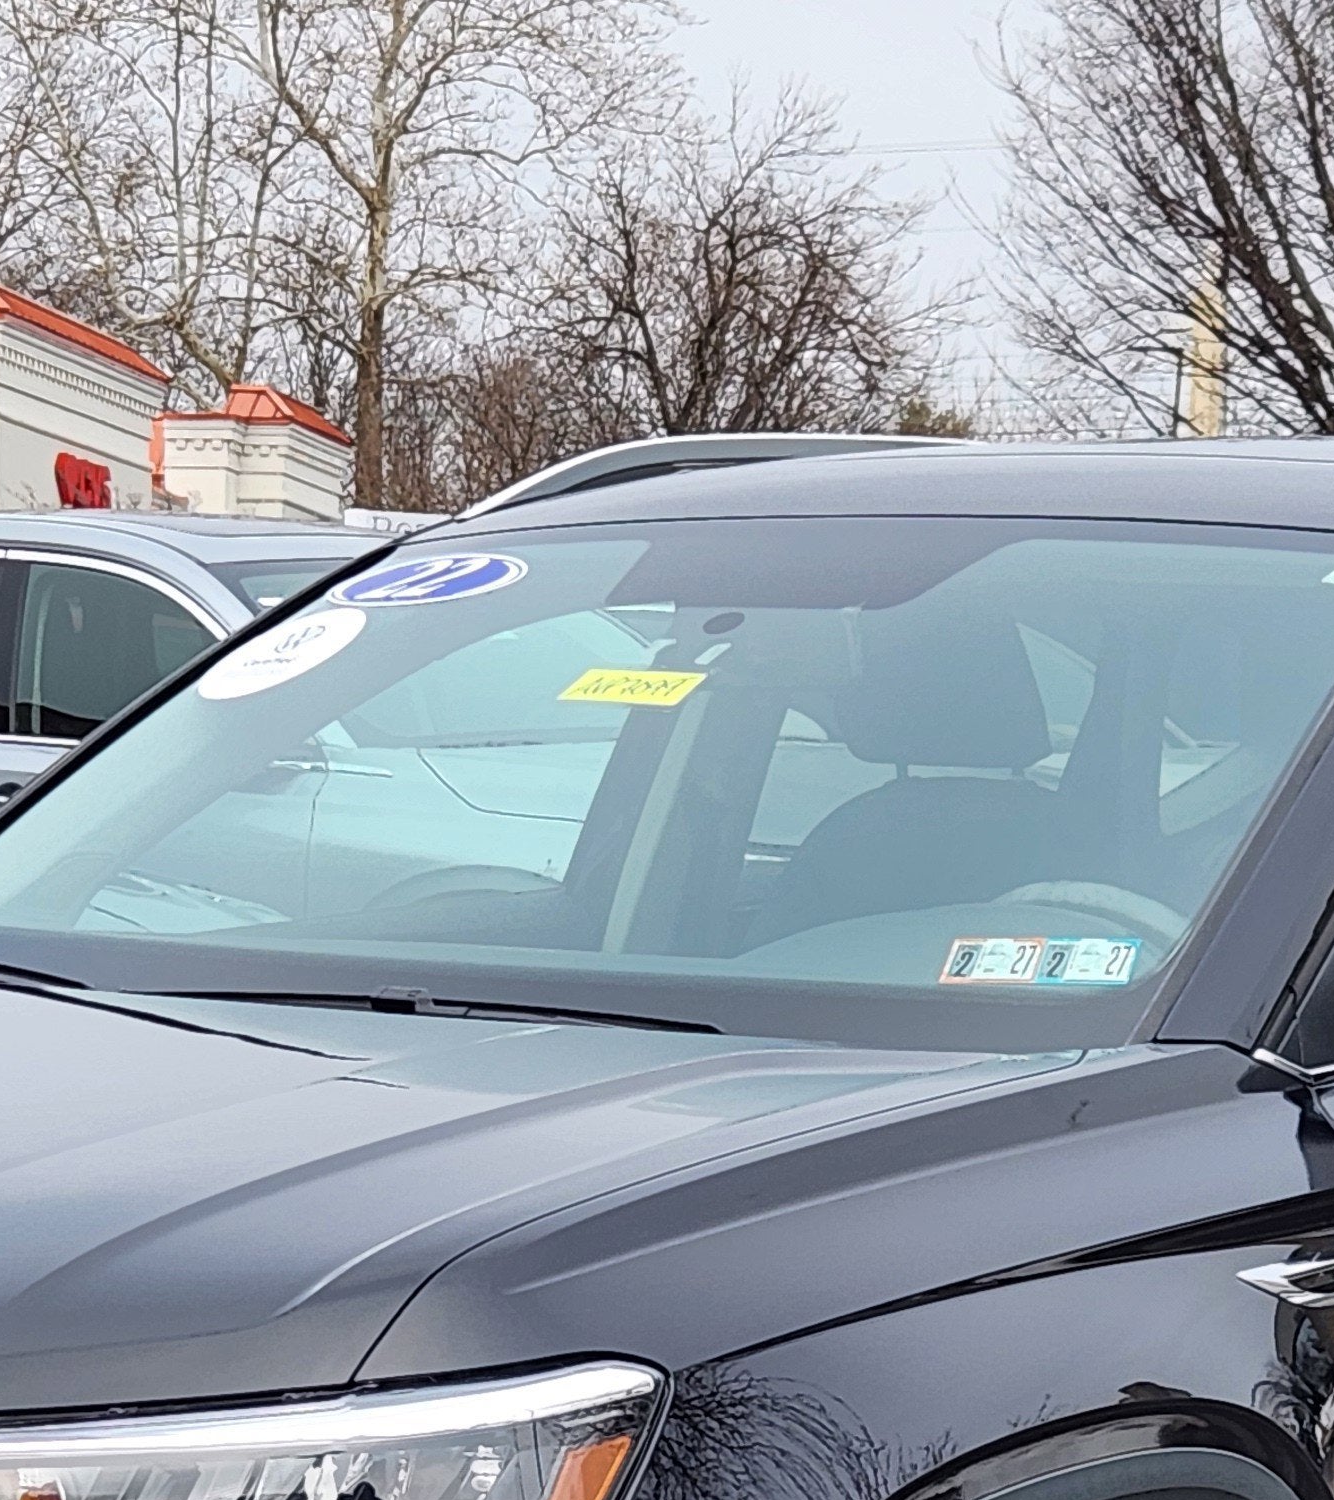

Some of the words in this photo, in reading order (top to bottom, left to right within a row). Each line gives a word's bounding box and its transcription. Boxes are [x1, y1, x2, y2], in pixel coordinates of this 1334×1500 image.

[354, 558, 491, 600] 22
[1010, 945, 1038, 977] 27
[1105, 945, 1133, 977] 27
